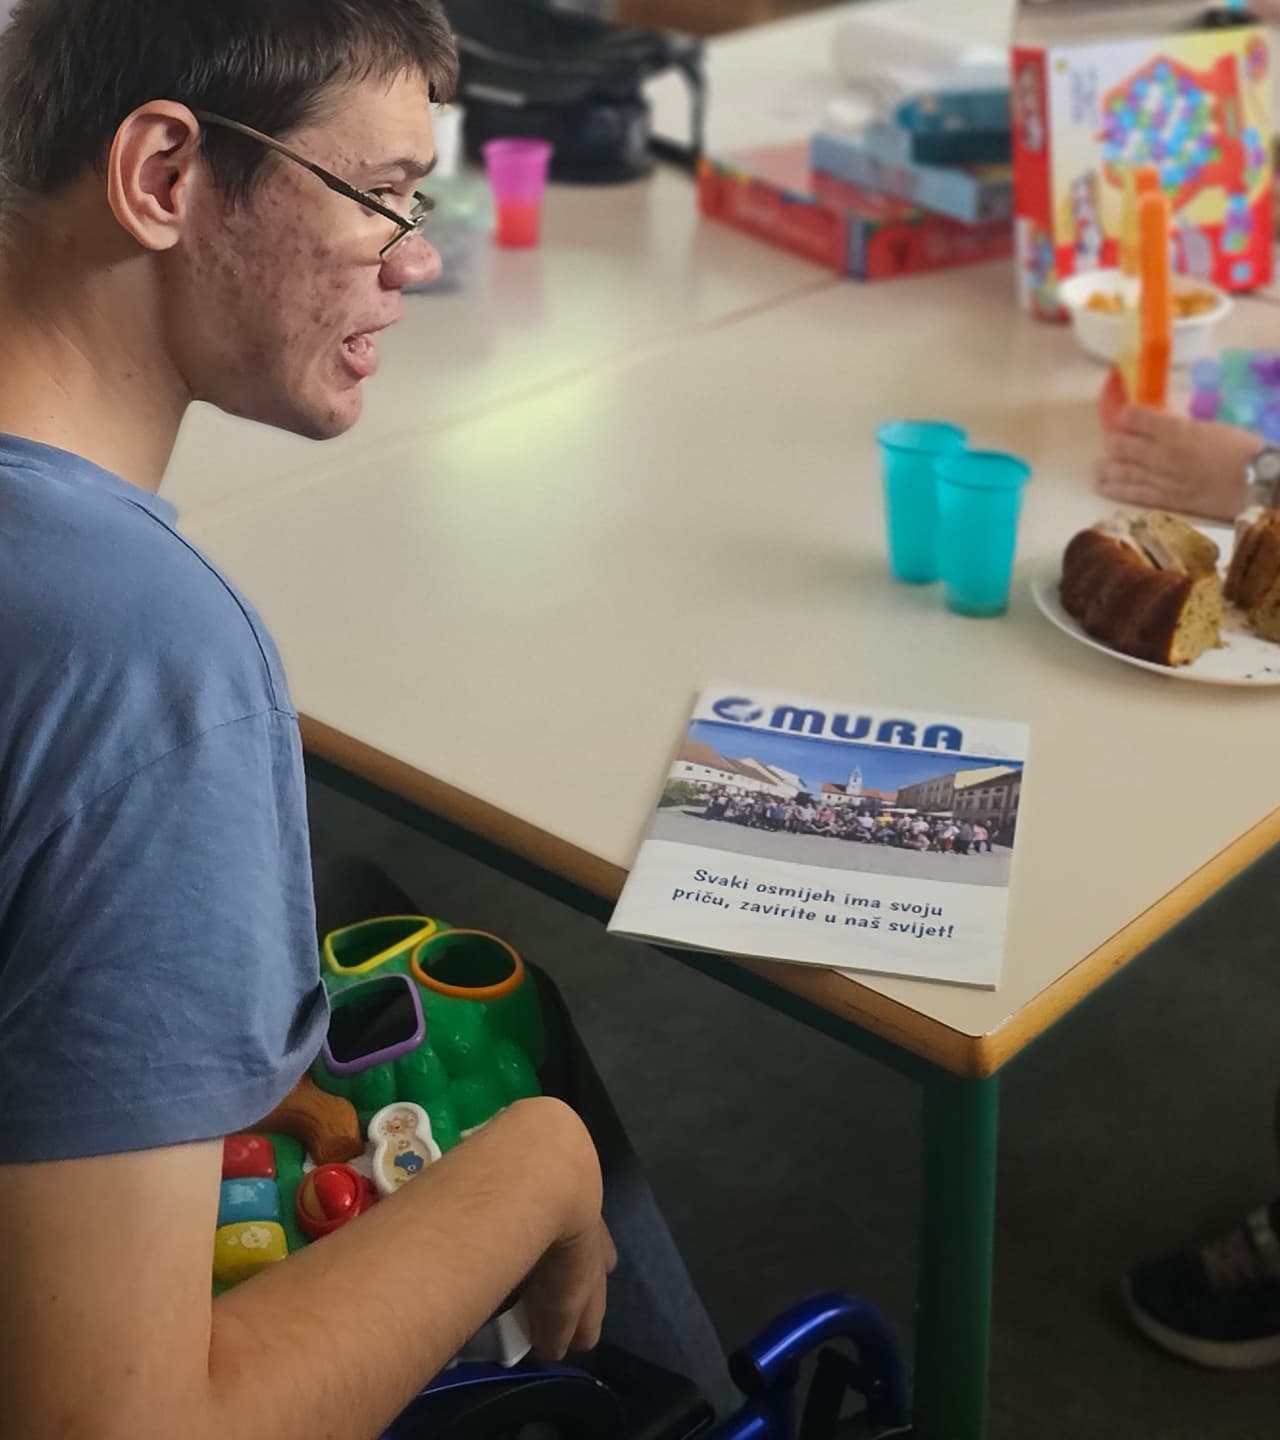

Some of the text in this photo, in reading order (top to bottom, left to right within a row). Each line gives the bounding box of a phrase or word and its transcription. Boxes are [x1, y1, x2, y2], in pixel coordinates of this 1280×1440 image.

[768, 704, 963, 752] MURA
[671, 886, 955, 939] priču, zavirite u naš svijet!
[693, 868, 944, 918] Svaki osmijeh ima svoju
